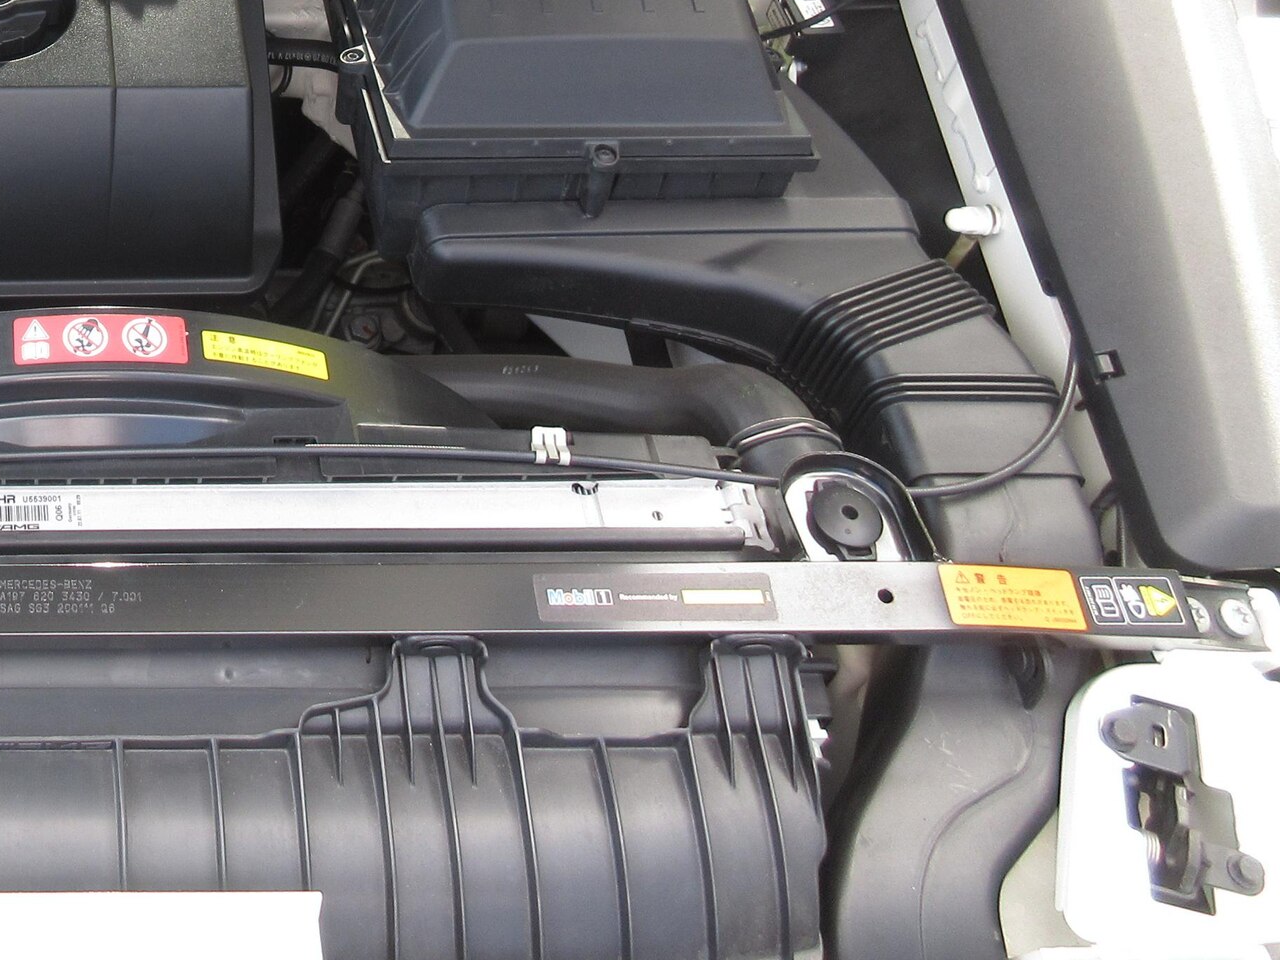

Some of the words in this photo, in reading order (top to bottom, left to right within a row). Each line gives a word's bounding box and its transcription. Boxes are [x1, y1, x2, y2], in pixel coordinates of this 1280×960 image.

[0, 579, 93, 590] MERCEDES-BENZ
[0, 591, 26, 602] A197
[33, 590, 55, 602] 620
[62, 591, 91, 602] 3430
[546, 588, 595, 606] Mobil
[618, 592, 668, 602] Recommended
[669, 593, 679, 603] by
[0, 602, 22, 614] SAG
[28, 602, 51, 614] SG3
